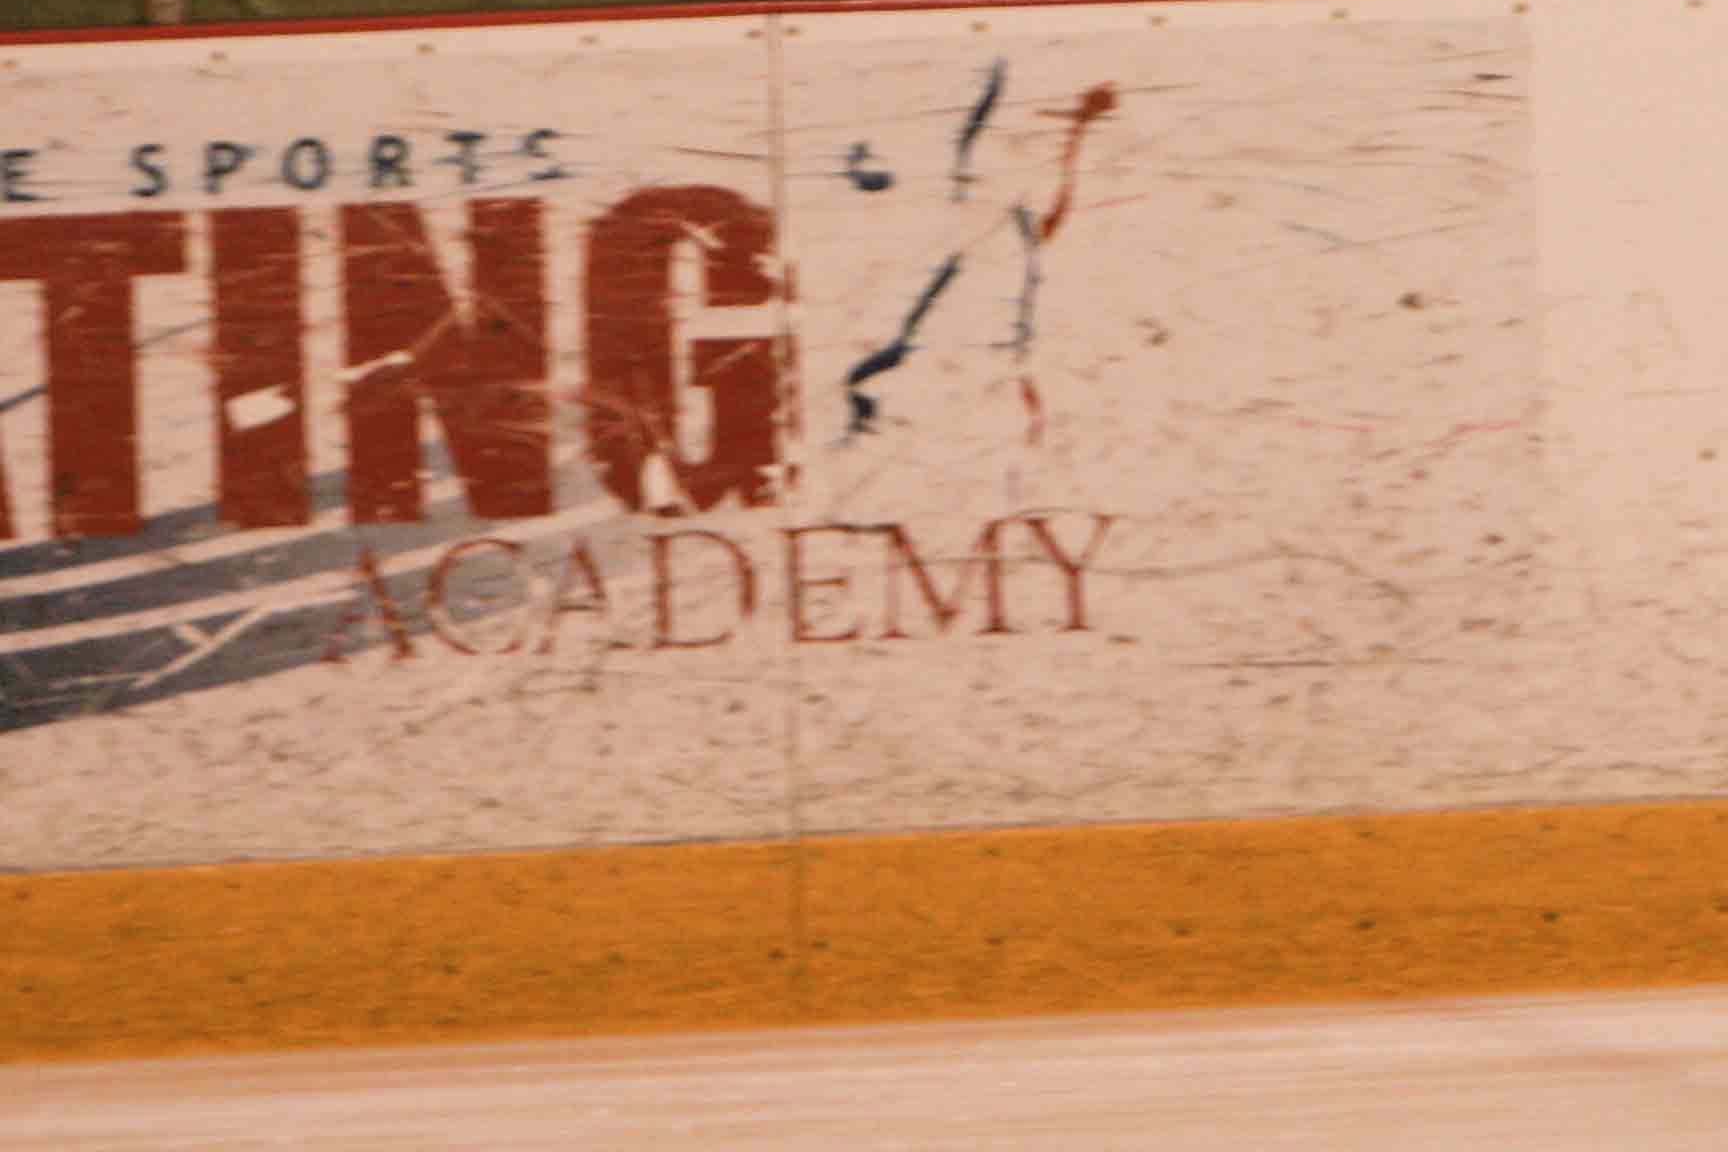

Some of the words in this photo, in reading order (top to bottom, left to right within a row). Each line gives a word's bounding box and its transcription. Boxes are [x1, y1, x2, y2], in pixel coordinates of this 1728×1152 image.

[128, 129, 568, 199] SPORTS
[0, 184, 797, 542] TING
[322, 513, 1117, 663] ACADEMY
